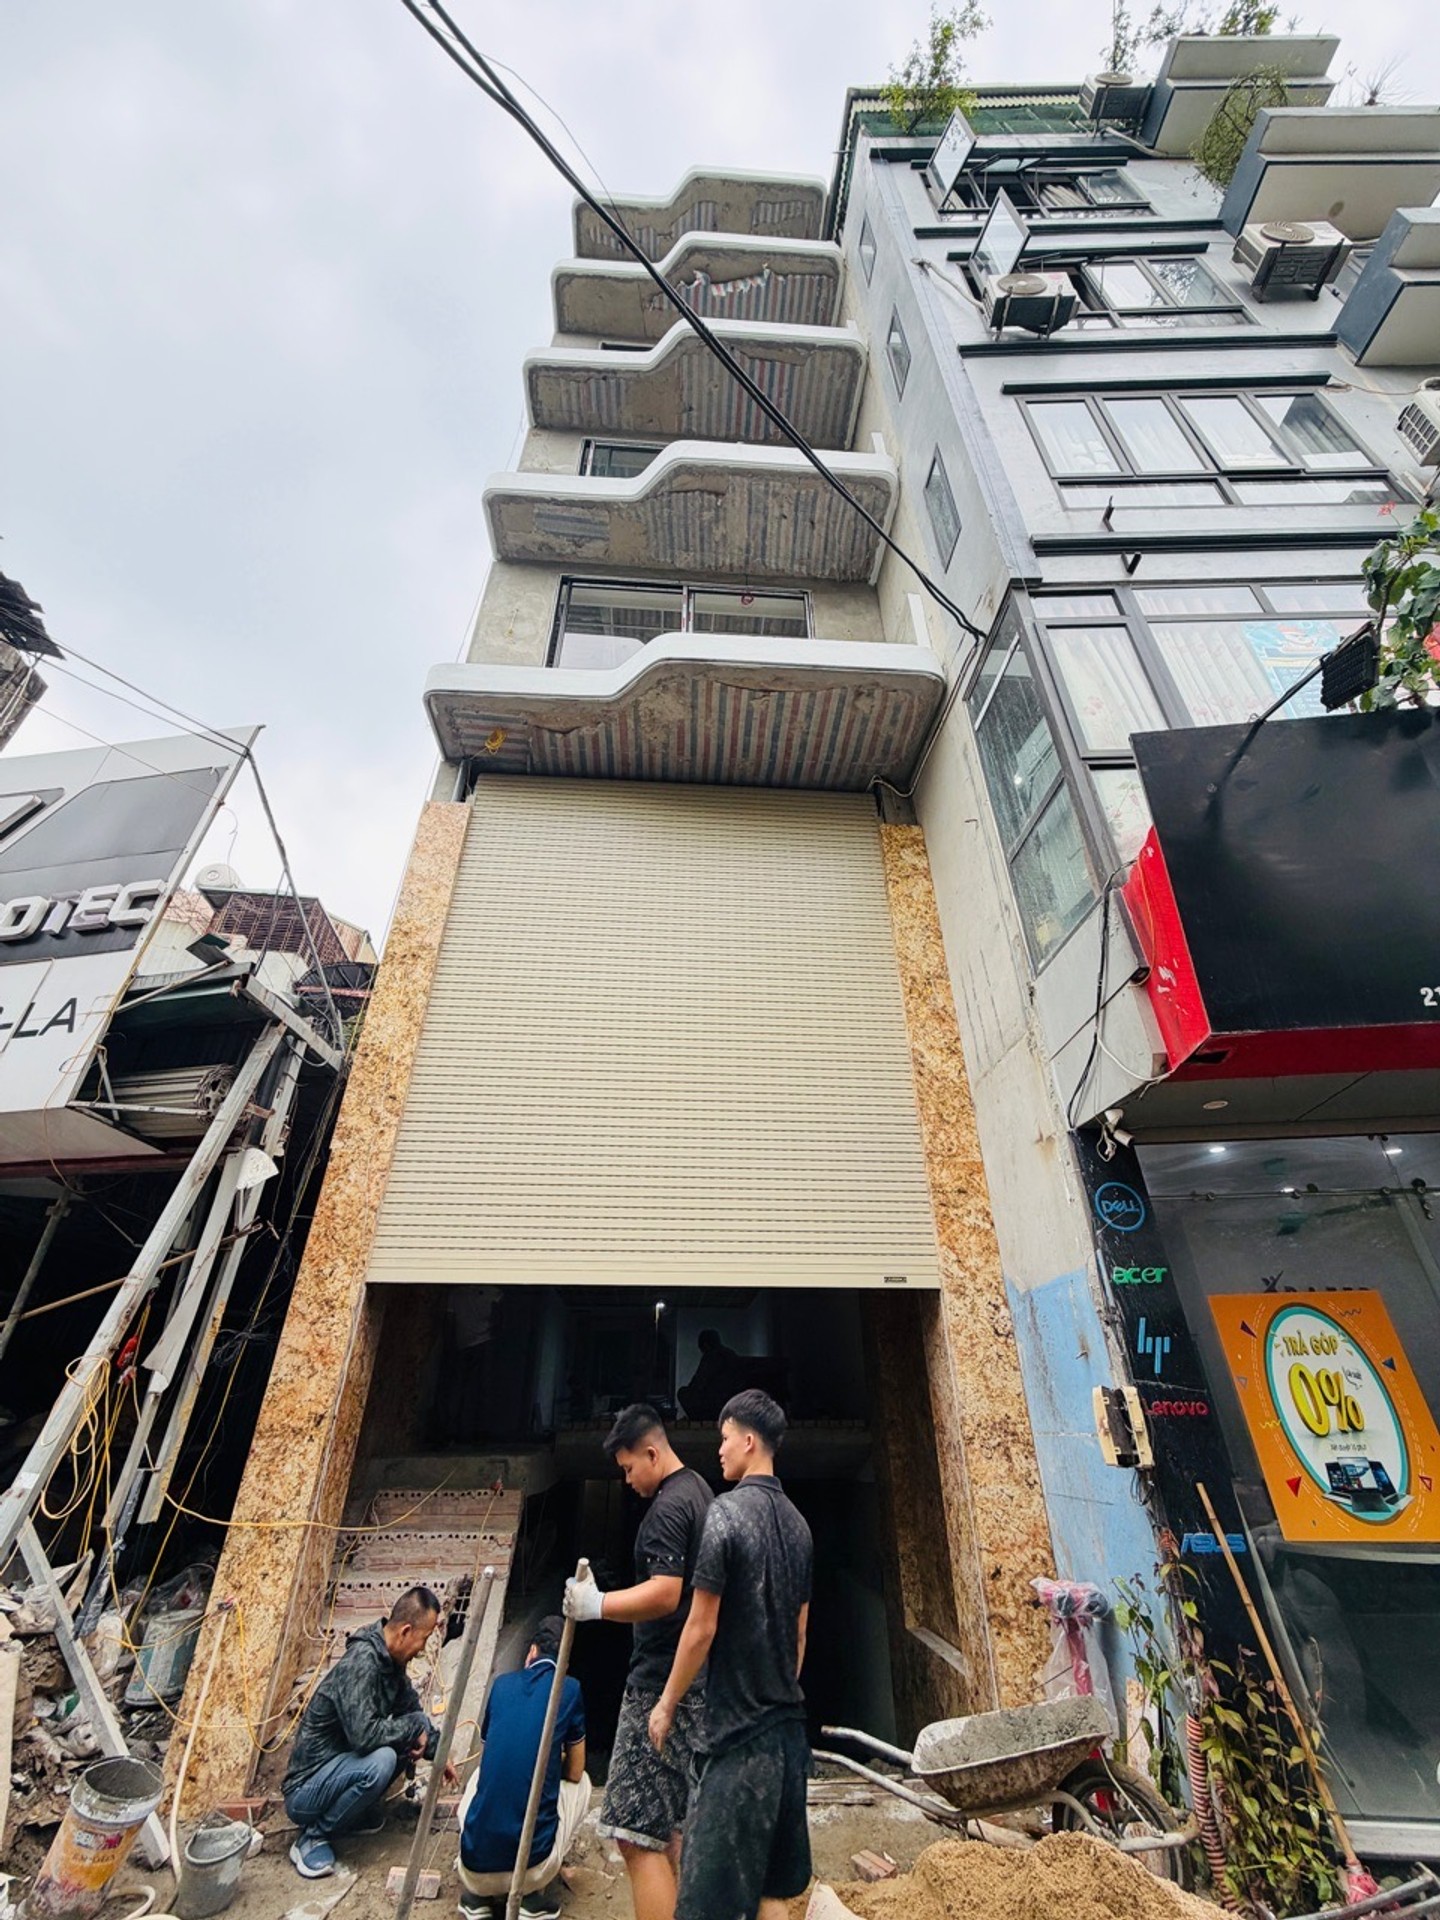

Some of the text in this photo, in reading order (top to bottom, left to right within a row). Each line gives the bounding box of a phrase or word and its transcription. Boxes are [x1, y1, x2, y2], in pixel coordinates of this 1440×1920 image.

[1101, 1199, 1140, 1214] DELL
[1113, 1266, 1168, 1285] acer
[1137, 1316, 1171, 1374] hp
[1309, 1331, 1339, 1356] GÓP
[1288, 1362, 1365, 1437] 0%
